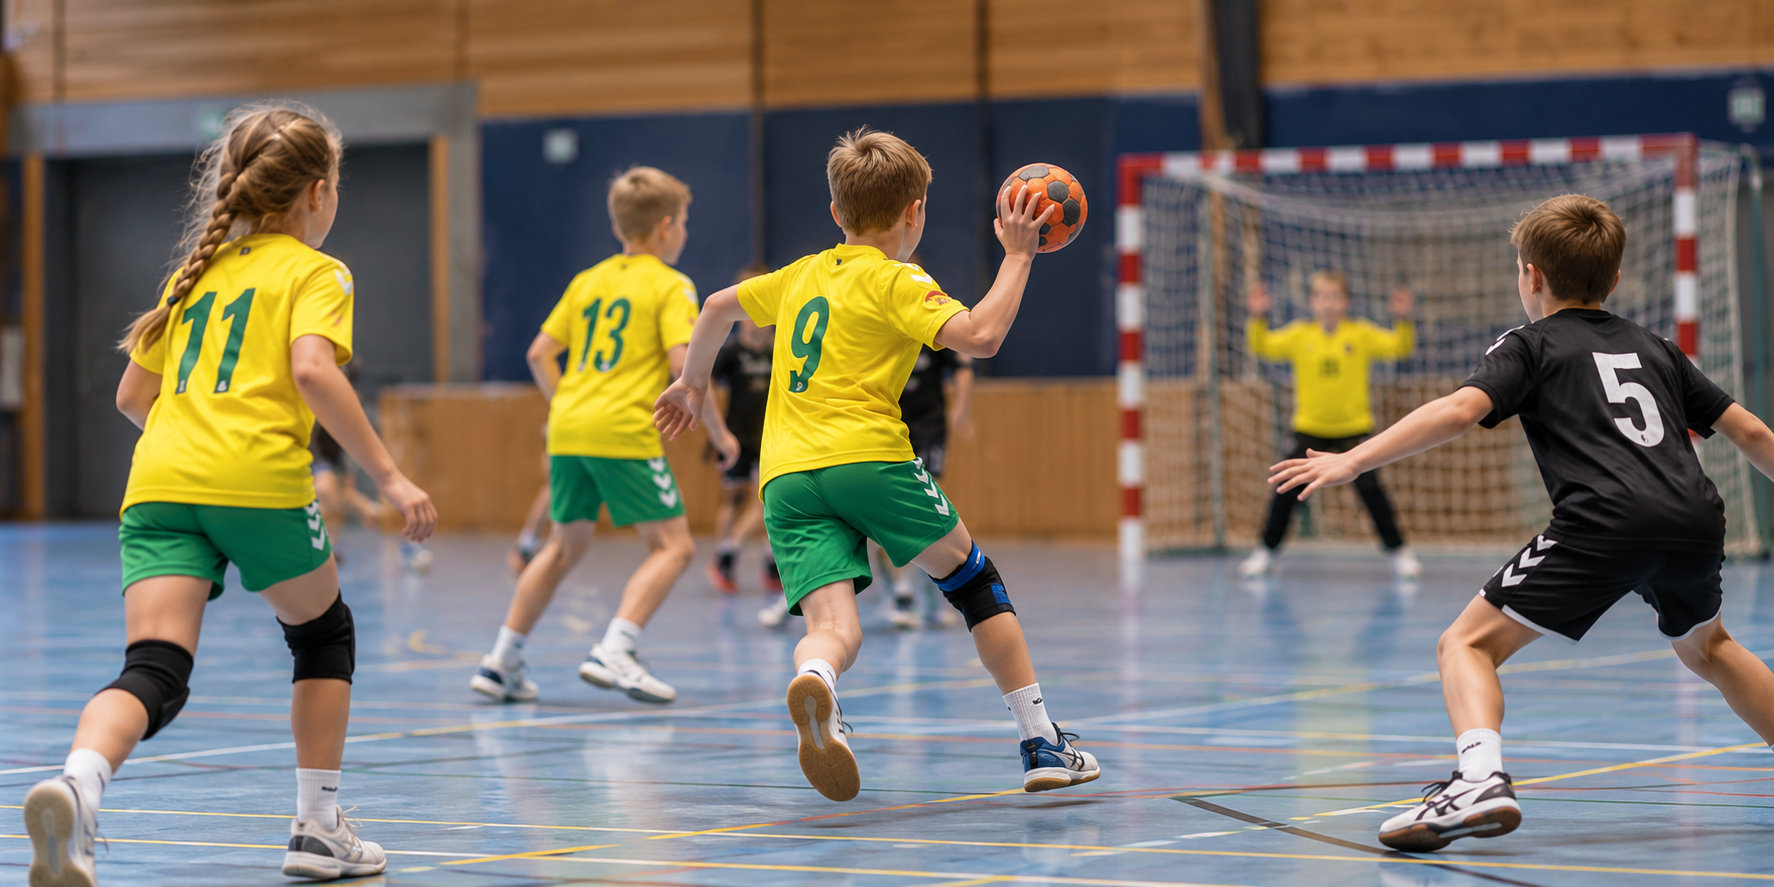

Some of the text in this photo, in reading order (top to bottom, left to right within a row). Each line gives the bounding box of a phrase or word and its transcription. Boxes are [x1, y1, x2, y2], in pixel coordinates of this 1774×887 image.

[175, 287, 256, 395] 11
[577, 297, 631, 373] 13
[788, 295, 830, 393] 9
[1592, 352, 1664, 447] 5
